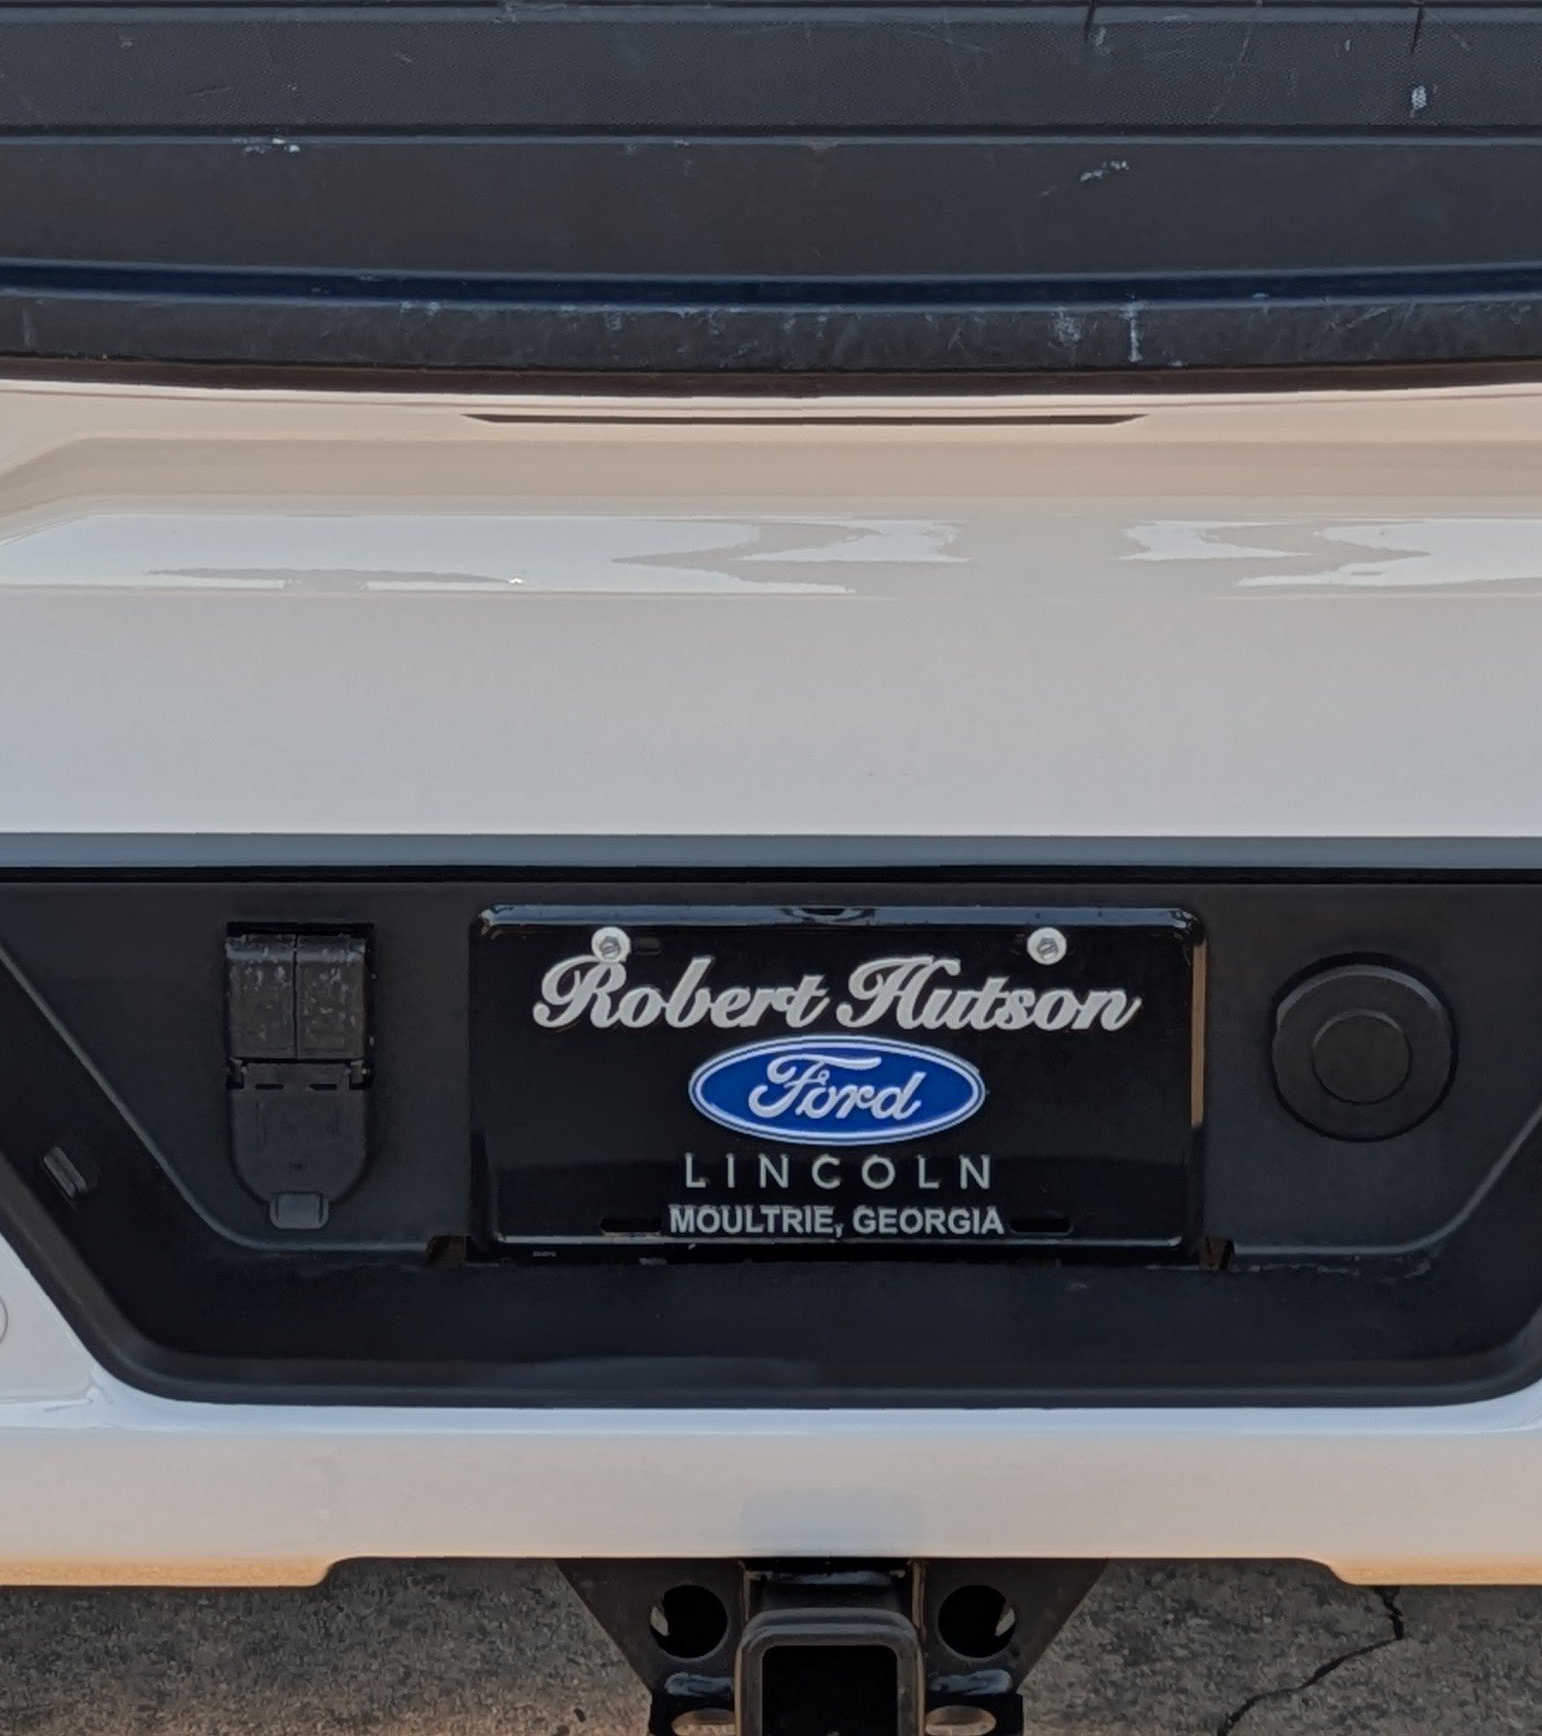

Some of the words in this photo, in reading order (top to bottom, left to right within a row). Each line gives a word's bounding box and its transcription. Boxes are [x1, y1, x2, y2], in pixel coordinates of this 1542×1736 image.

[532, 956, 831, 1030] Robert
[835, 956, 1143, 1031] Hutson
[748, 1053, 925, 1120] Ford
[685, 1154, 991, 1190] LINCOLN
[669, 1206, 846, 1236] MOULTRIE,
[853, 1205, 1005, 1234] GEORGIA
